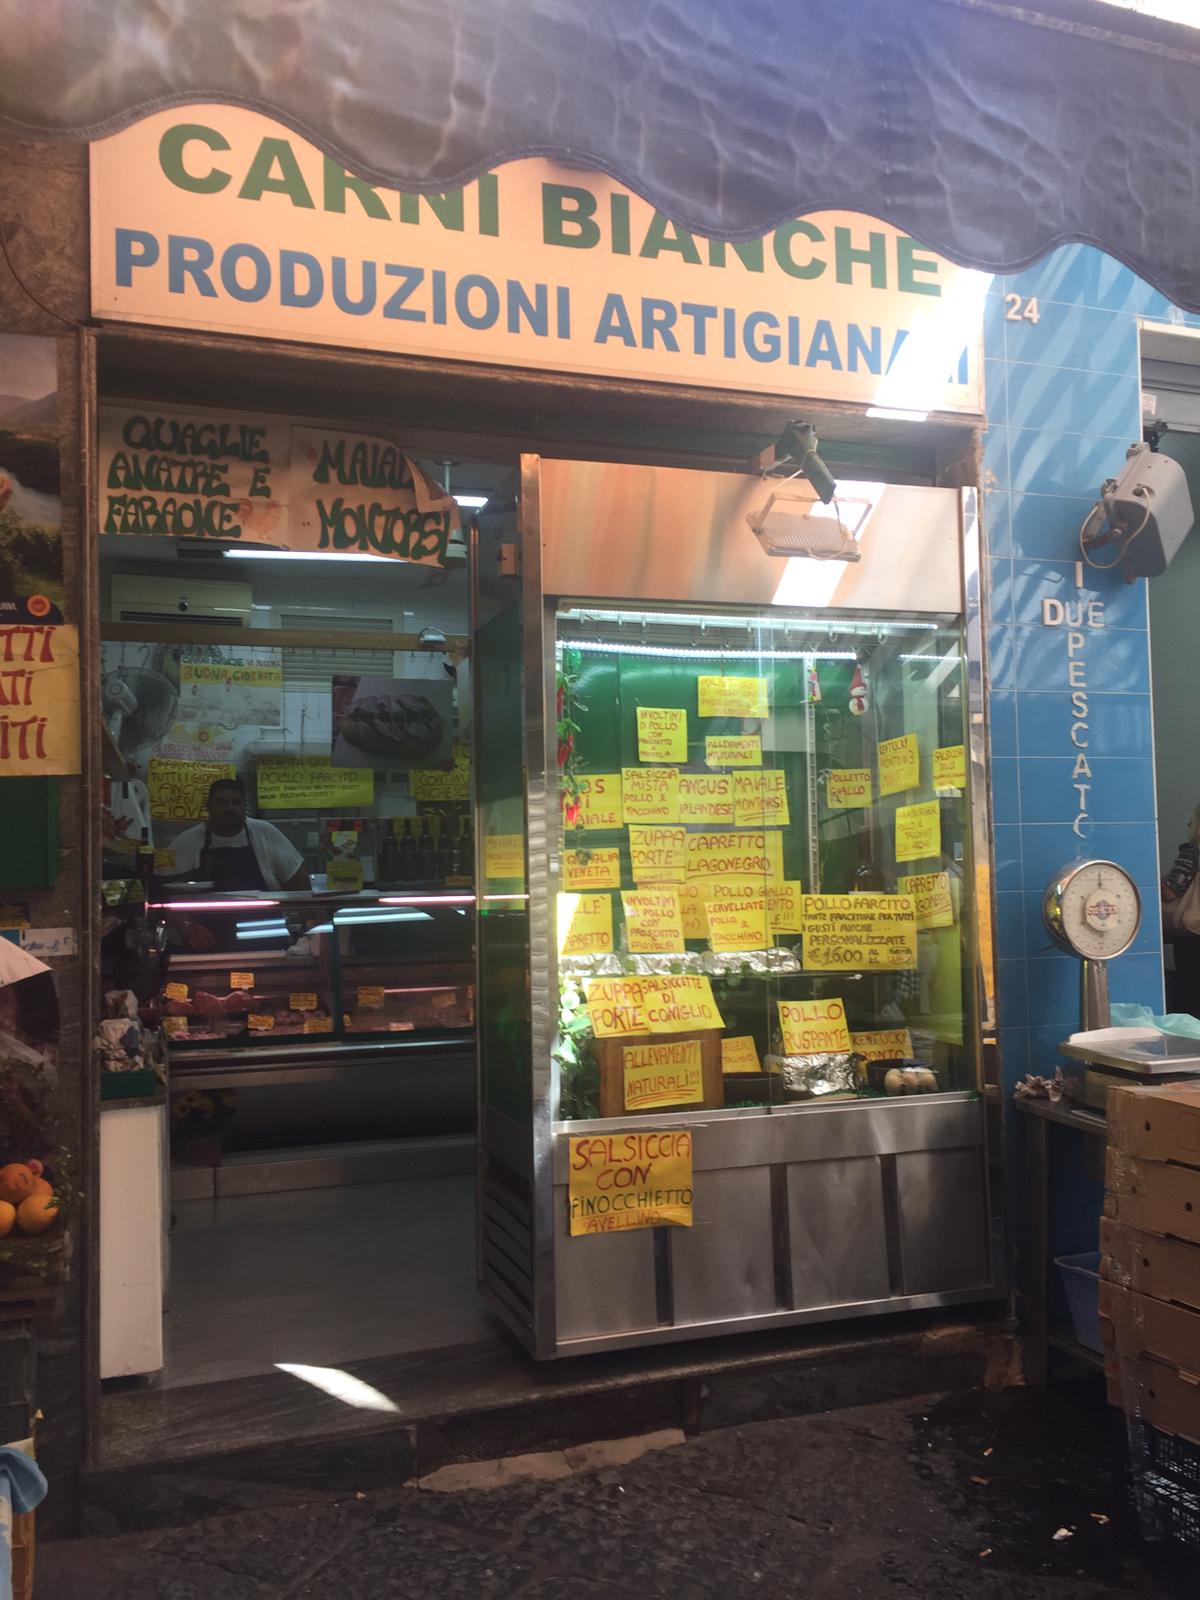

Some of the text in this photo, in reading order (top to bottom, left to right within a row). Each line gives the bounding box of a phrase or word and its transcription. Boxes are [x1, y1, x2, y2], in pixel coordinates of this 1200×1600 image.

[115, 228, 970, 385] PRODUZIONI ARTIGIANI
[1004, 292, 1041, 324] 24
[123, 416, 268, 461] QUAGLIE
[107, 452, 272, 497] ANATRE E
[104, 494, 240, 538] FARAONE
[1043, 598, 1106, 630] DUE
[678, 778, 729, 796] ANGUS
[631, 828, 686, 848] ZUPPA
[687, 834, 766, 853] CAPRETTO
[687, 855, 771, 873] LAGONEGRO
[713, 885, 753, 898] POLLO
[803, 897, 911, 913] POLLO FARCITO
[589, 982, 645, 1003] ZUPPA
[662, 991, 676, 1004] DI
[648, 1004, 712, 1023] CONIGLIO
[781, 1003, 843, 1025] POLLO
[784, 1028, 849, 1052] RUSPANTE
[572, 1134, 691, 1171] SALSICCIA
[596, 1163, 653, 1191] CON
